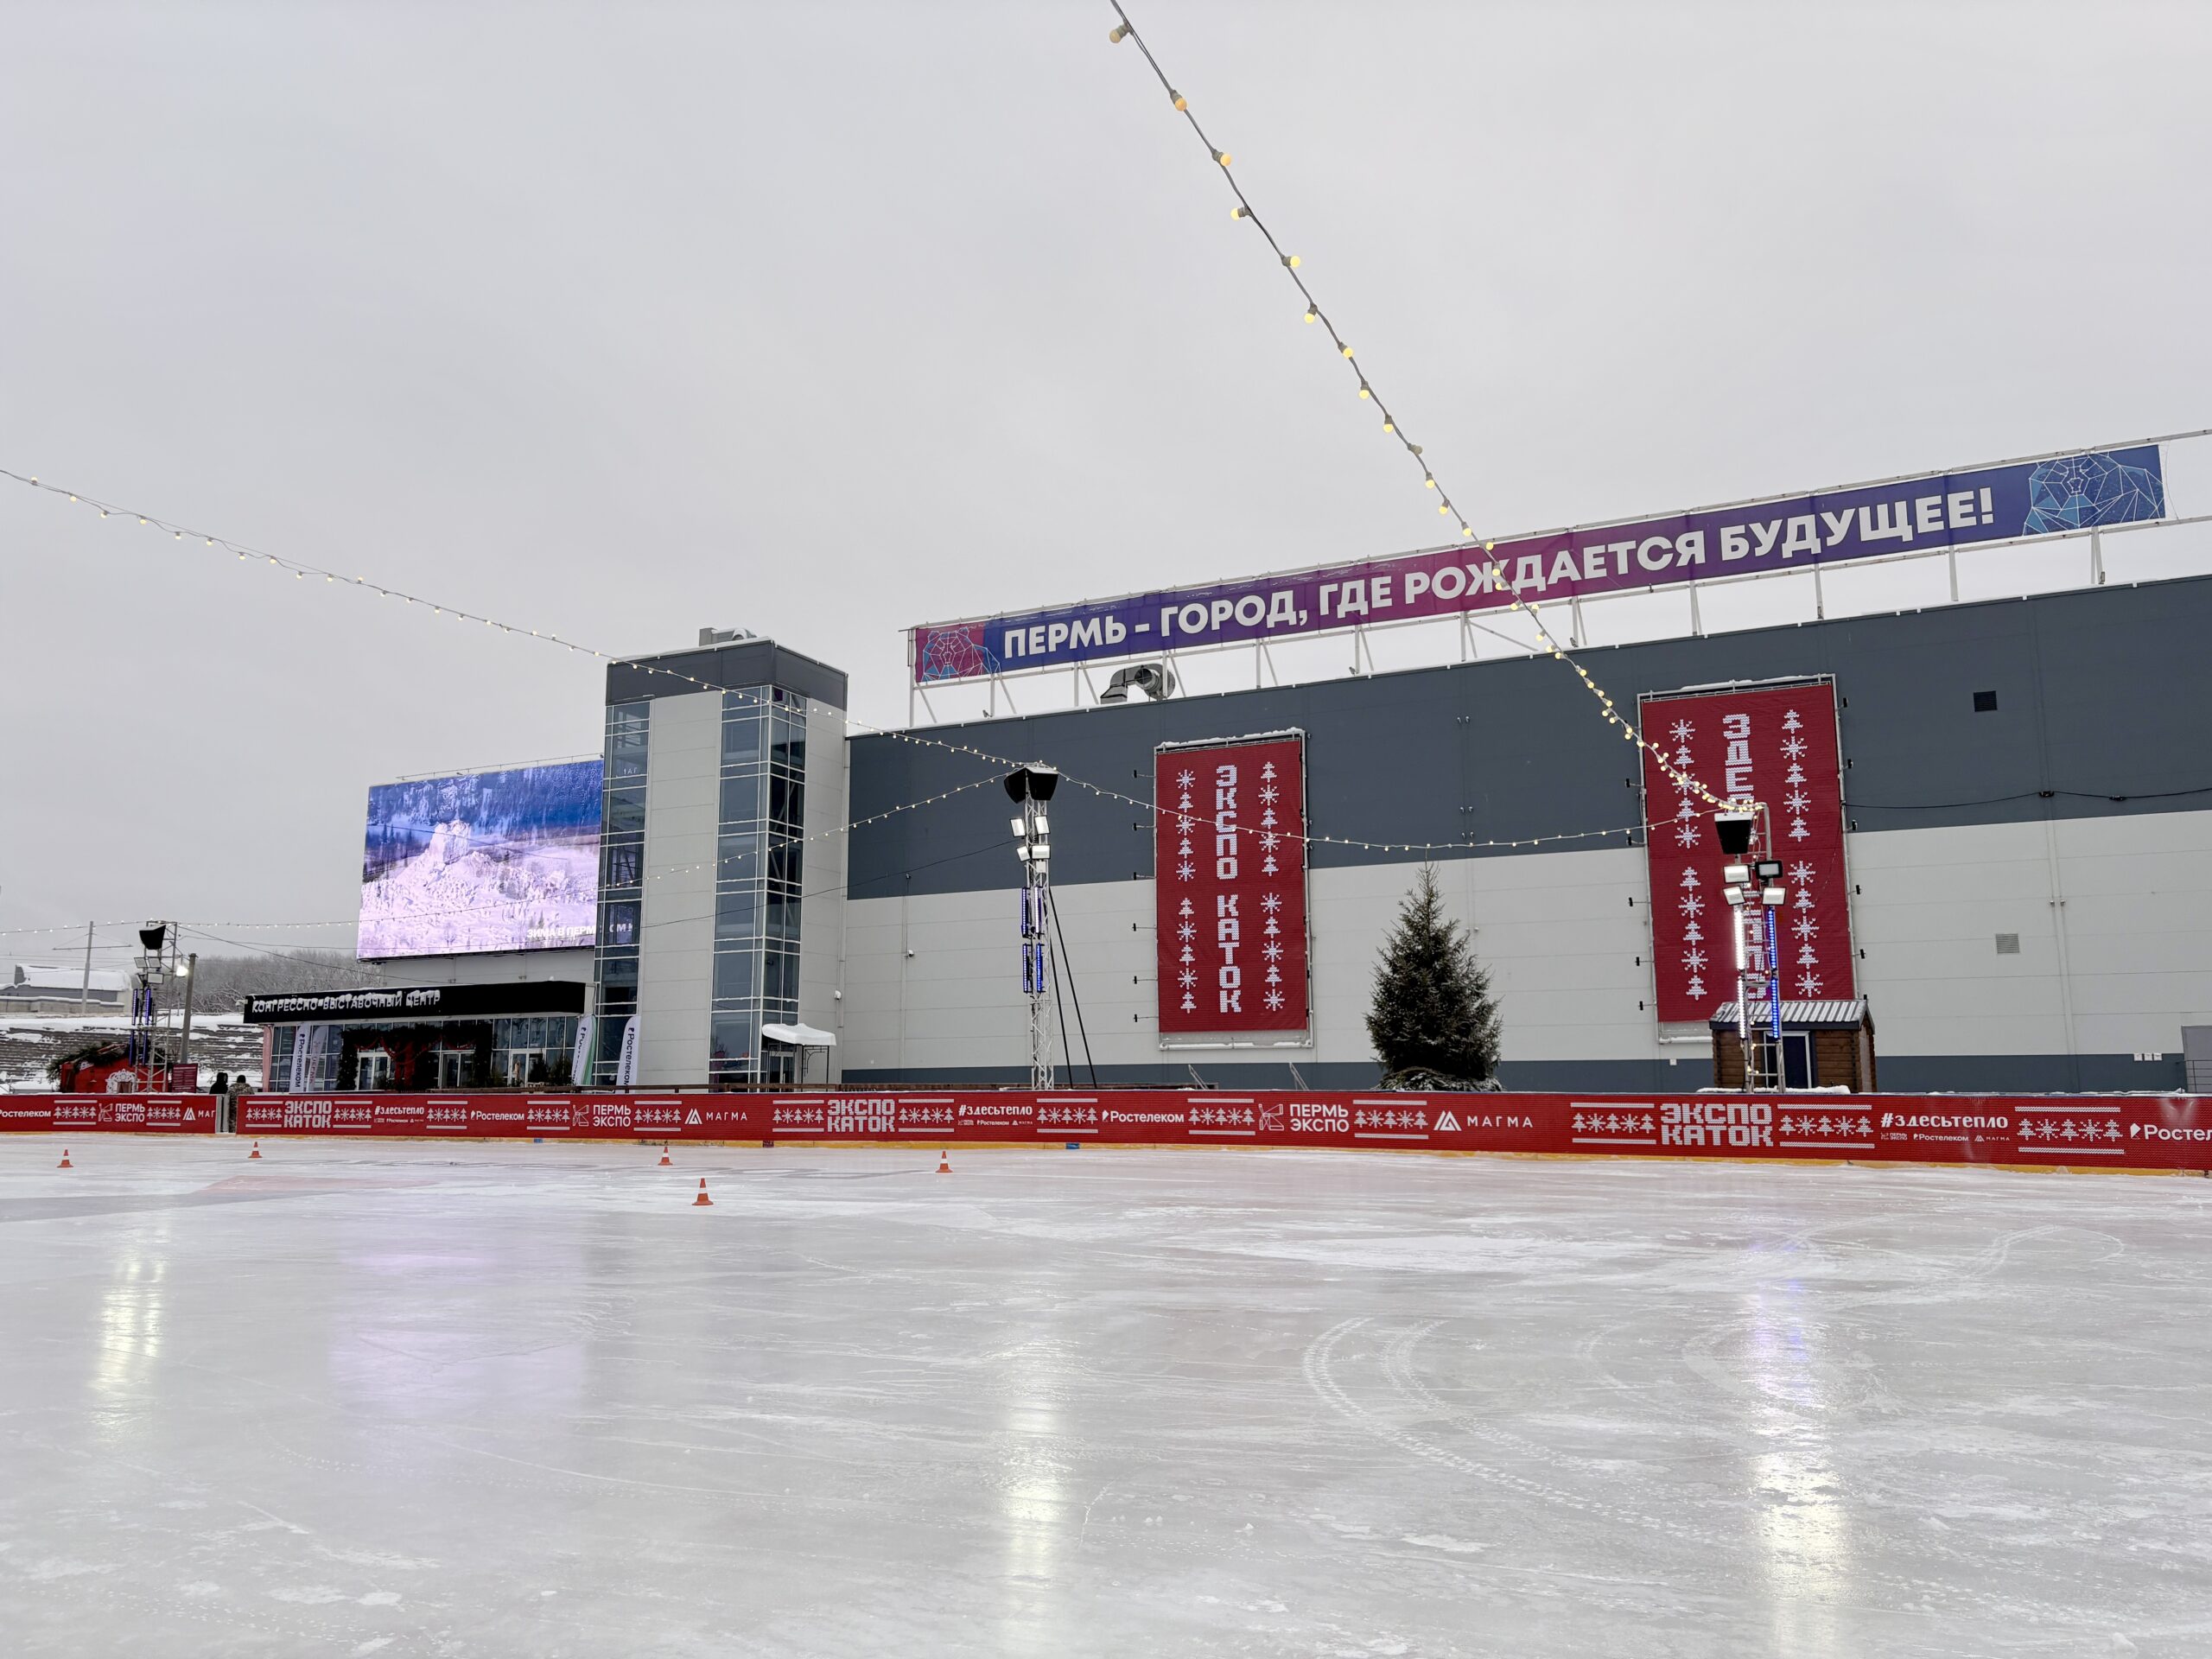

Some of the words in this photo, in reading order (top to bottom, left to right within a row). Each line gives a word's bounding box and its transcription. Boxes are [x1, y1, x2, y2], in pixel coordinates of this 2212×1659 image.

[1004, 615, 1127, 658] ПЕРМЬ
[1160, 590, 1308, 637] ГОРОД,
[1319, 575, 1393, 620] ГДЕ
[1405, 531, 1706, 605] РОЖДАЕТСЯ
[1719, 487, 1994, 562] БУДУЩЕЕ!
[1216, 765, 1238, 880] ЭКСПО
[1217, 894, 1242, 1014] КАТОК
[406, 990, 440, 1007] ЦЕНТР
[296, 1039, 306, 1088] Ростелеком
[115, 1103, 145, 1113] ПЕРМЬ
[284, 1101, 333, 1114] ЭКСПО
[593, 1105, 632, 1115] ПЕРМЬ
[827, 1099, 895, 1116] ЭКСПО
[958, 1104, 1033, 1116] #здесьтепло
[1289, 1103, 1349, 1117] ПЕРМЬ
[1660, 1103, 1771, 1124] ЭКСПО
[115, 1113, 145, 1122] ЭКСПО
[283, 1115, 332, 1128] КАТОК
[476, 1110, 524, 1121] Ростелеком
[593, 1116, 631, 1127] ЭКСПО
[706, 1112, 747, 1121] МАГМА
[1110, 1110, 1185, 1122] Ростелеком
[1467, 1116, 1533, 1128] МАГМА
[1880, 1113, 2008, 1128] #здесьтепло
[827, 1116, 895, 1133] КАТОК
[1290, 1118, 1350, 1133] ЭКСПО
[1661, 1125, 1773, 1147] КАТОК
[1919, 1133, 1969, 1141] Ростелеком
